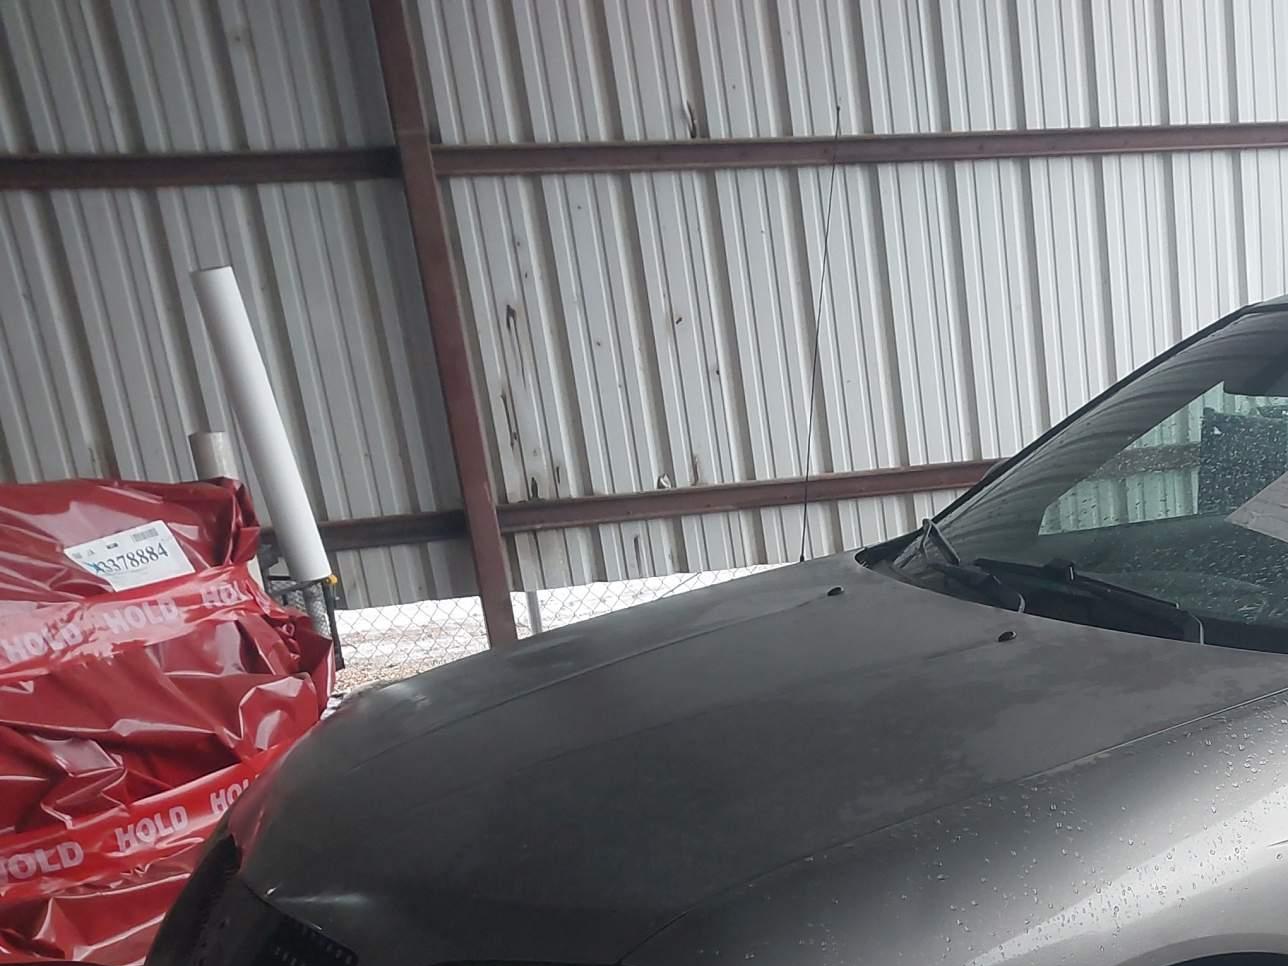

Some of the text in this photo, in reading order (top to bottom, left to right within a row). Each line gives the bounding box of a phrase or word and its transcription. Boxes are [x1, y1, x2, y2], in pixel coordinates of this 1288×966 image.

[1, 622, 84, 663] HOLD
[103, 597, 179, 634] HOLD
[114, 806, 190, 852] HOLD
